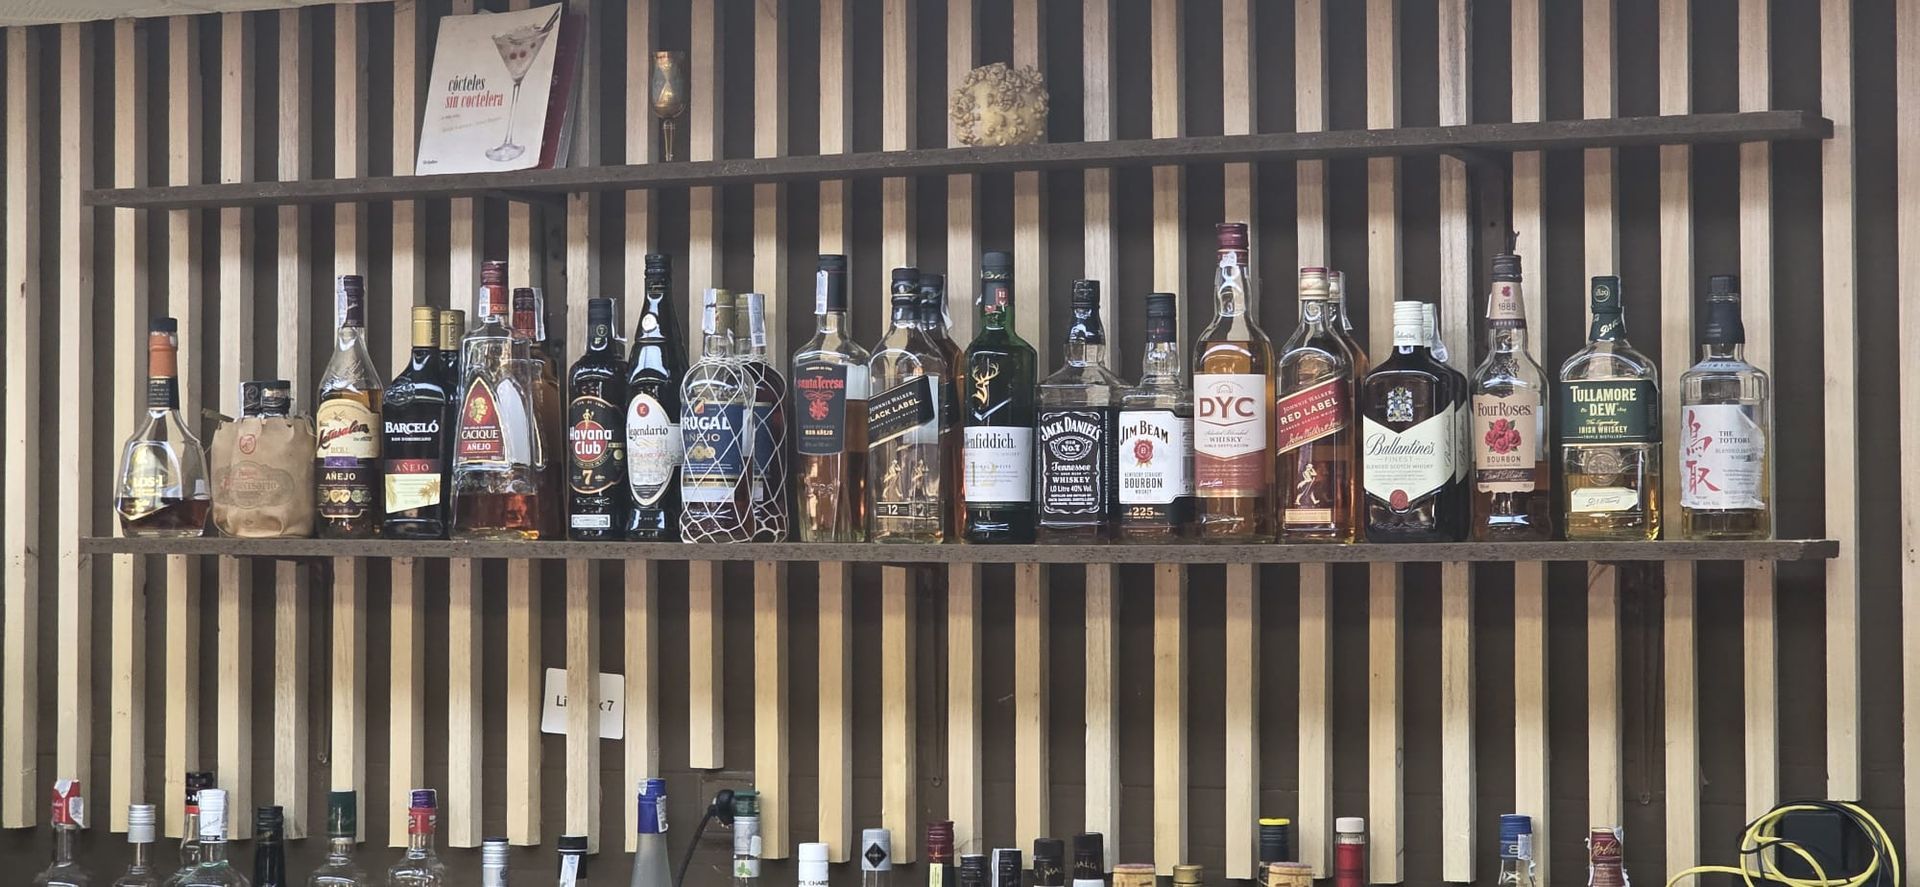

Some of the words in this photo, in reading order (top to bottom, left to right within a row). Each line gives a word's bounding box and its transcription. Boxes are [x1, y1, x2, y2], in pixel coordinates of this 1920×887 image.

[445, 92, 459, 109] sin
[461, 90, 503, 107] coctelera
[1570, 386, 1638, 403] TULLAMORE
[892, 398, 922, 413] LABEL
[1199, 396, 1255, 418] DYC
[1280, 411, 1302, 426] RED
[1303, 397, 1339, 417] LABEL
[1478, 402, 1499, 418] Four
[385, 420, 440, 435] BARCELÓ
[570, 426, 613, 441] Havana
[1041, 421, 1064, 441] JACK
[1120, 425, 1138, 446] JIM
[1139, 420, 1169, 444] BEAM
[1579, 426, 1597, 434] IRISH
[1597, 426, 1628, 434] WHISKEY
[461, 430, 500, 440] CACIQUE
[466, 441, 491, 451] AÑEJO
[575, 441, 602, 455] Club
[1366, 433, 1436, 455] Ballantine's
[395, 463, 430, 472] AÑEJO
[1051, 462, 1091, 471] Tennessee
[325, 471, 356, 481] AÑEJO
[582, 470, 593, 484] 7
[1124, 478, 1163, 489] BOURBON
[888, 504, 898, 515] 12
[1132, 507, 1154, 517] 225
[607, 700, 615, 711] 7
